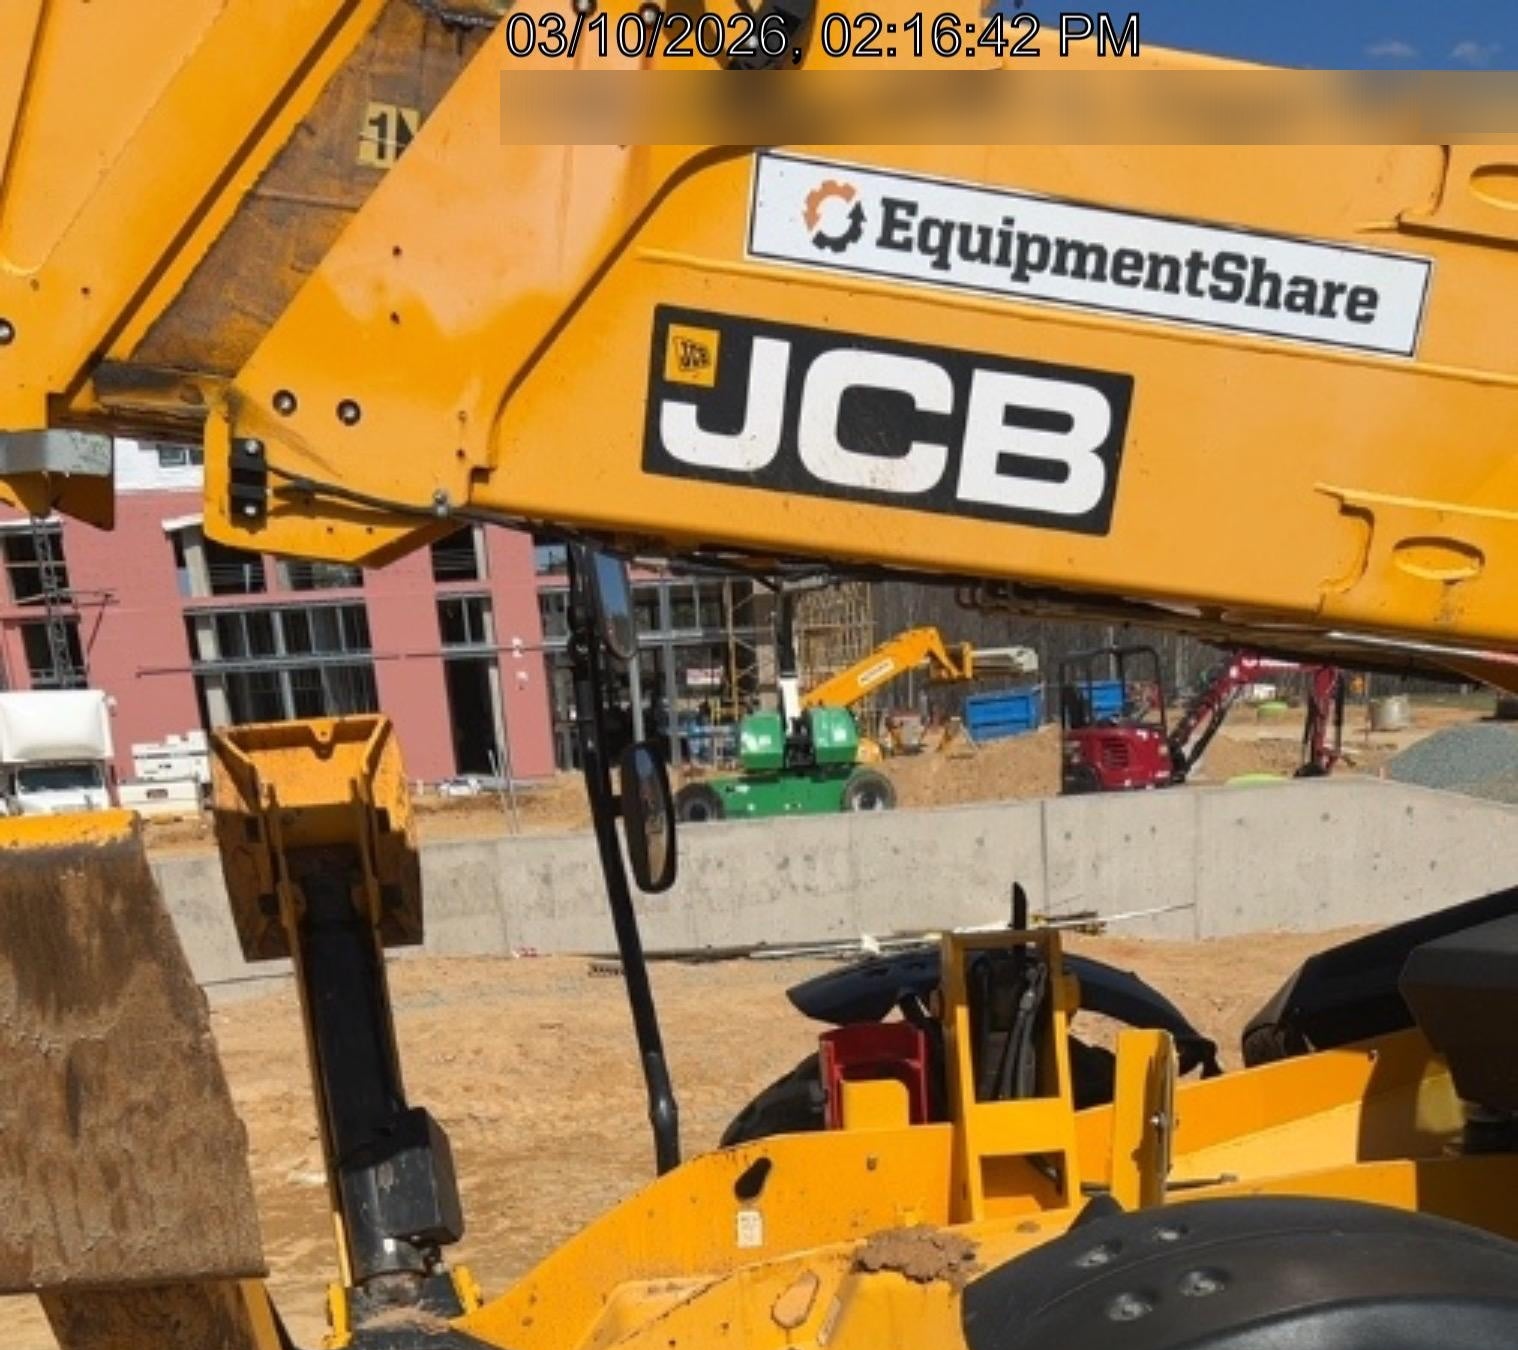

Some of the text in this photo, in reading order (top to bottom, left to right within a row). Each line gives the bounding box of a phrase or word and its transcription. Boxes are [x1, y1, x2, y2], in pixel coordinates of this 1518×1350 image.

[368, 112, 388, 159] 1
[875, 197, 1380, 325] EquipmentShare
[659, 335, 1112, 516] JCB
